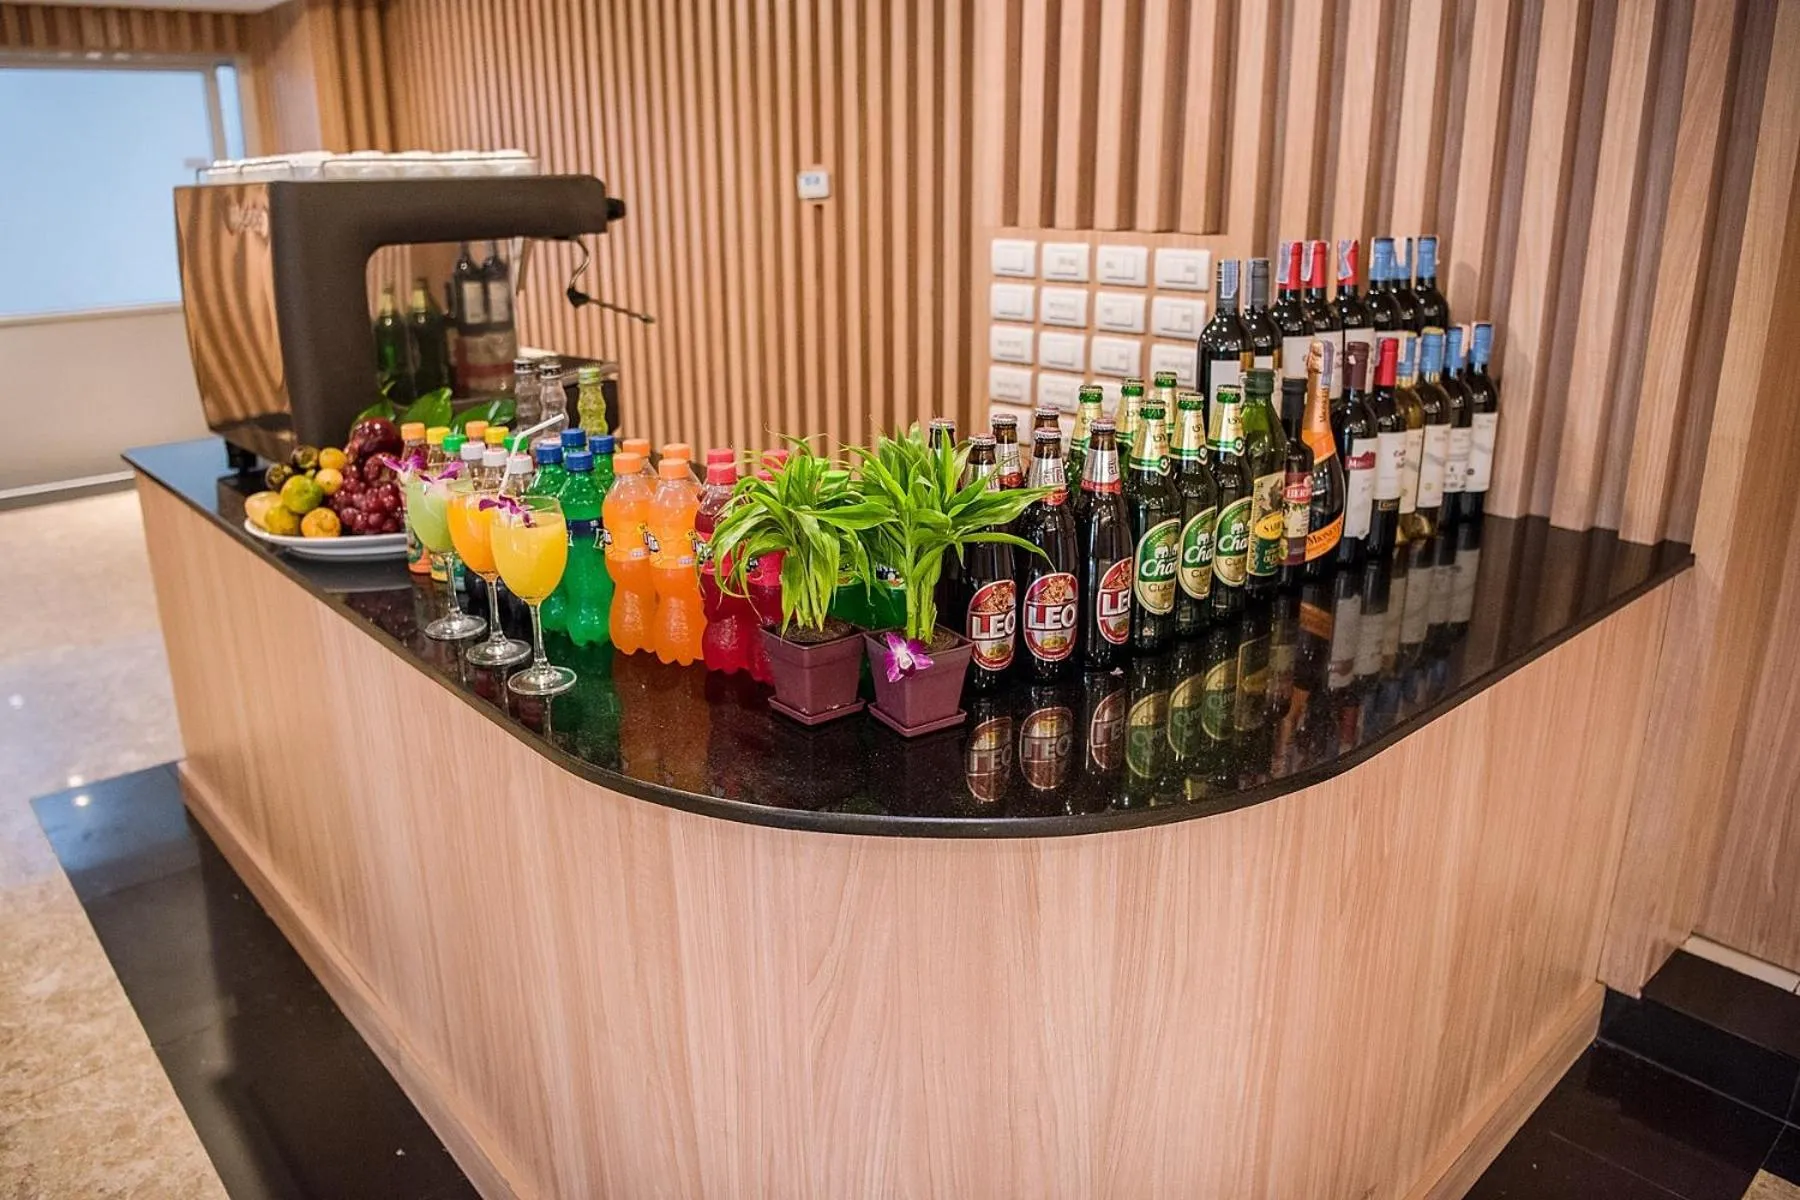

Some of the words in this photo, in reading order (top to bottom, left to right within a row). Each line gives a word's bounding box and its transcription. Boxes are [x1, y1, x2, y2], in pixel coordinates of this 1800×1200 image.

[1184, 546, 1212, 563] Cha
[1218, 534, 1248, 552] Cha
[1102, 591, 1130, 616] LE
[972, 610, 1016, 639] LEO
[1028, 604, 1076, 629] LEO
